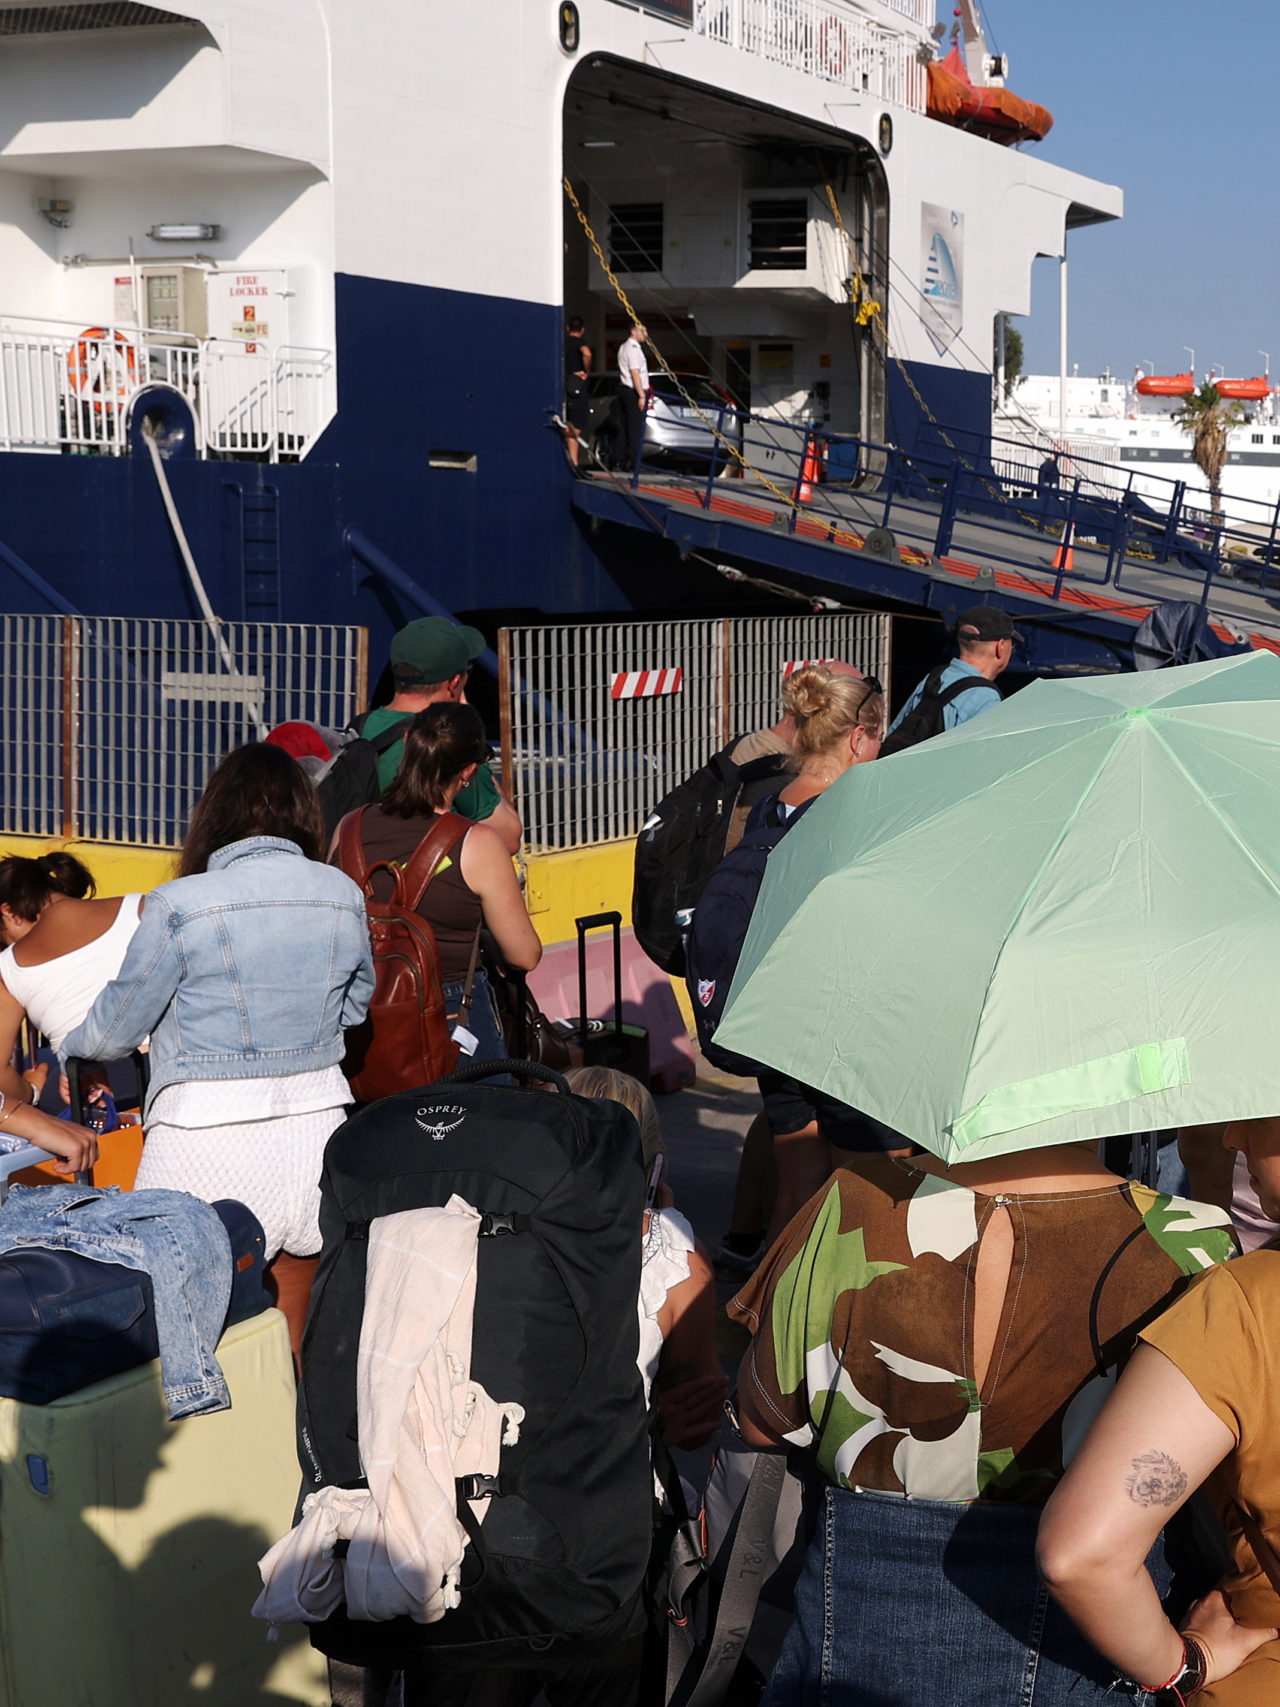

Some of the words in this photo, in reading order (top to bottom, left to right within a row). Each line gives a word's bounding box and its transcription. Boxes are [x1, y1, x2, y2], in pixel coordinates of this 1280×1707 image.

[236, 276, 258, 286] FIRE
[229, 287, 268, 297] LOCKER
[417, 1105, 467, 1116] OSPREY
[740, 1540, 768, 1578] V&L
